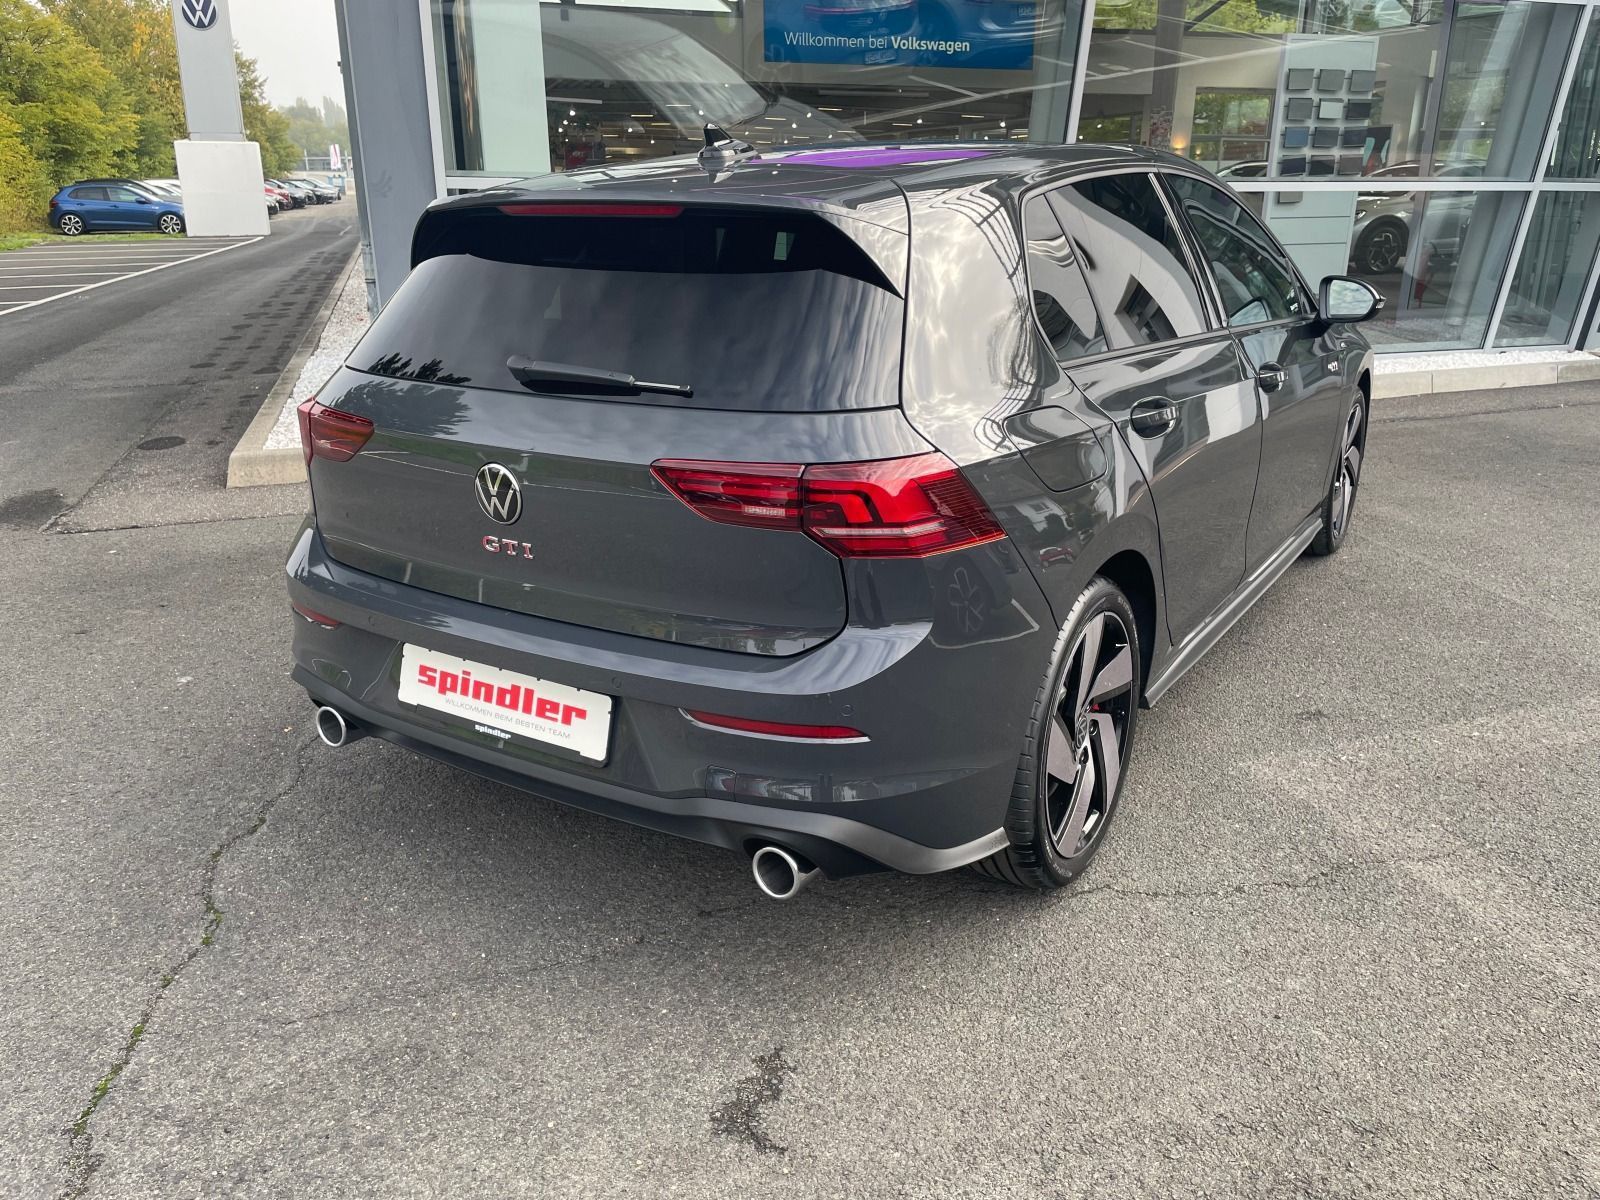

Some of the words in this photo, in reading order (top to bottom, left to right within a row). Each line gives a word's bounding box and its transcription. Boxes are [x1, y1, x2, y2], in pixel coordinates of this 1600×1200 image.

[784, 31, 865, 49] Willkommen
[869, 34, 888, 49] bei
[890, 35, 971, 55] Volkswagen
[475, 463, 522, 525] VW
[482, 535, 534, 560] GTI
[417, 664, 588, 726] spindler
[446, 697, 493, 717] WILLKOMMEN
[494, 712, 513, 724] BEIM
[515, 717, 546, 733] BESTEN
[549, 727, 571, 739] TEAM
[475, 724, 512, 739] spindler
